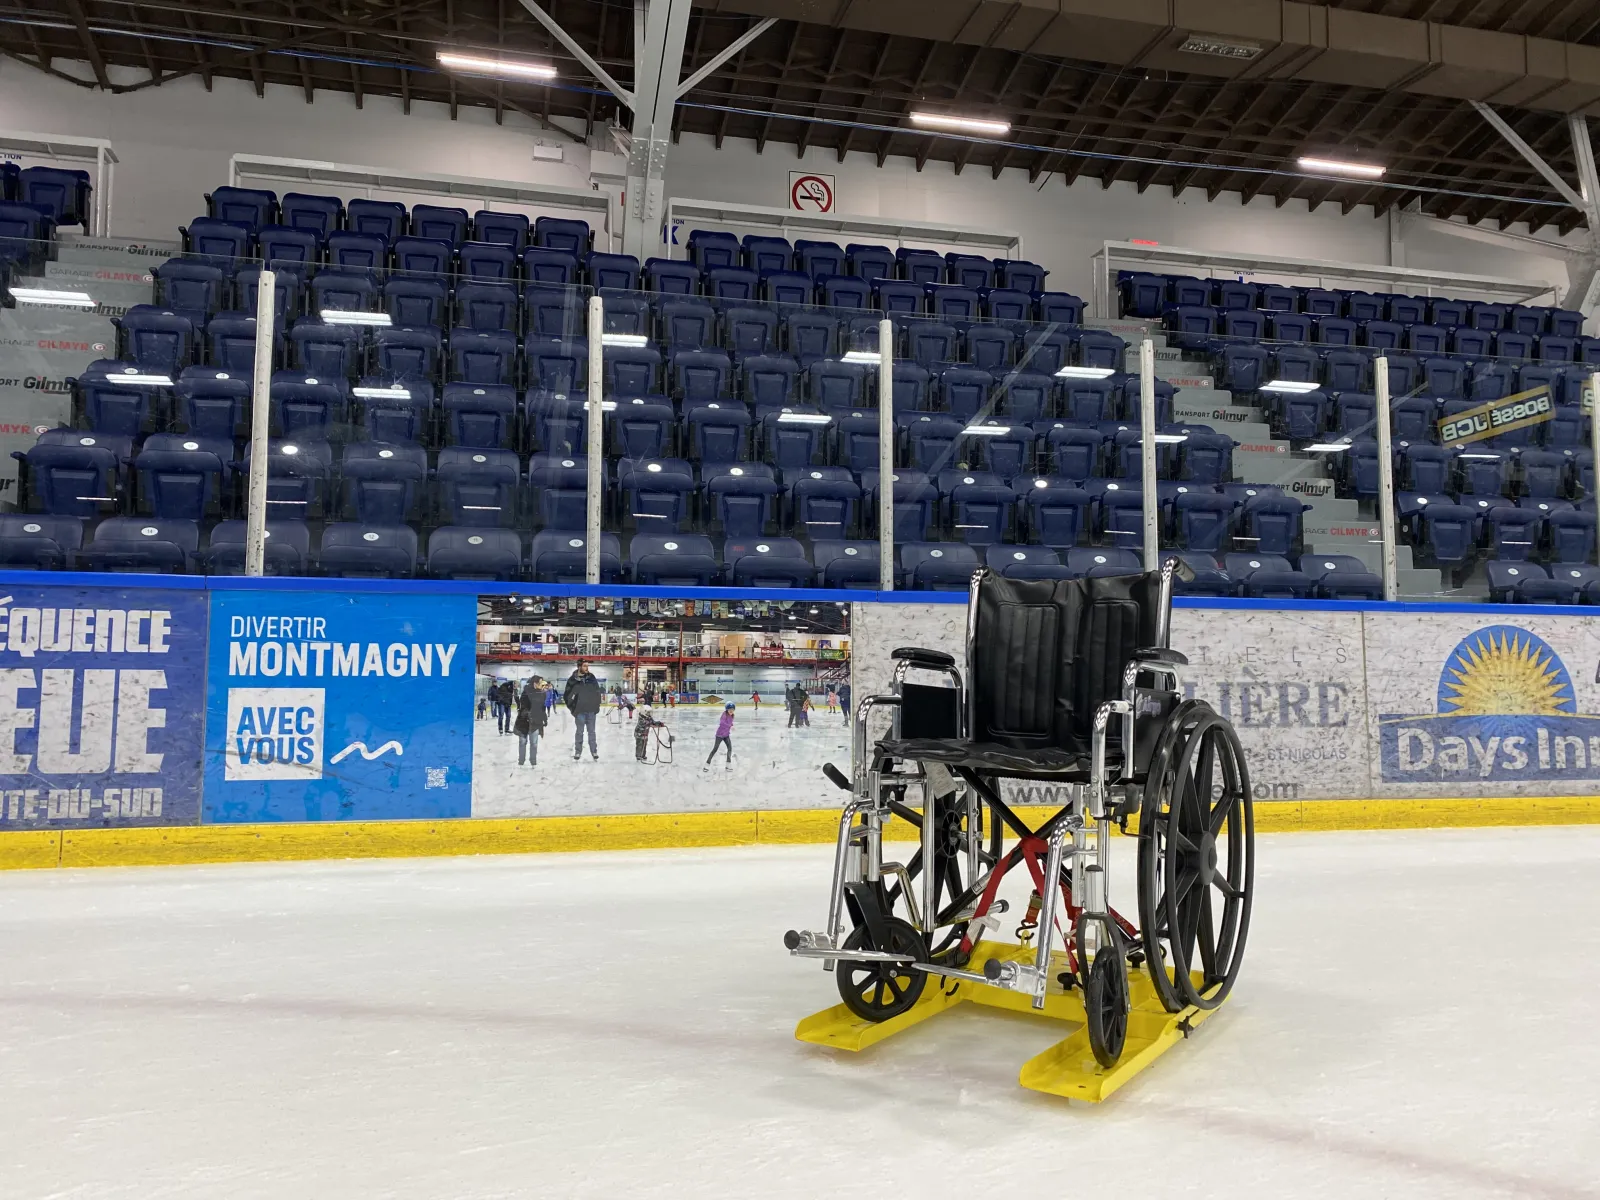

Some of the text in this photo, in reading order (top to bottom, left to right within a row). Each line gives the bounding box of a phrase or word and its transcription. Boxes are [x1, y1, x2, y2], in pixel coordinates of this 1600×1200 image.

[663, 224, 679, 245] K
[94, 269, 141, 282] GILMYR
[81, 300, 127, 316] Gilmy
[38, 340, 89, 351] GILMYR
[1168, 377, 1199, 387] GILMYR
[1212, 409, 1249, 422] Gilmyr
[1240, 443, 1276, 453] GILMYR
[1292, 481, 1331, 497] Gilmyr
[1330, 527, 1368, 537] GILMYR
[231, 615, 327, 639] DIVERTIR
[229, 641, 457, 677] MONTMAGNY
[237, 706, 314, 736] AVEC
[236, 736, 314, 765] VOUS
[1397, 728, 1528, 777] Days
[0, 788, 163, 820] TE-DU-SUD
